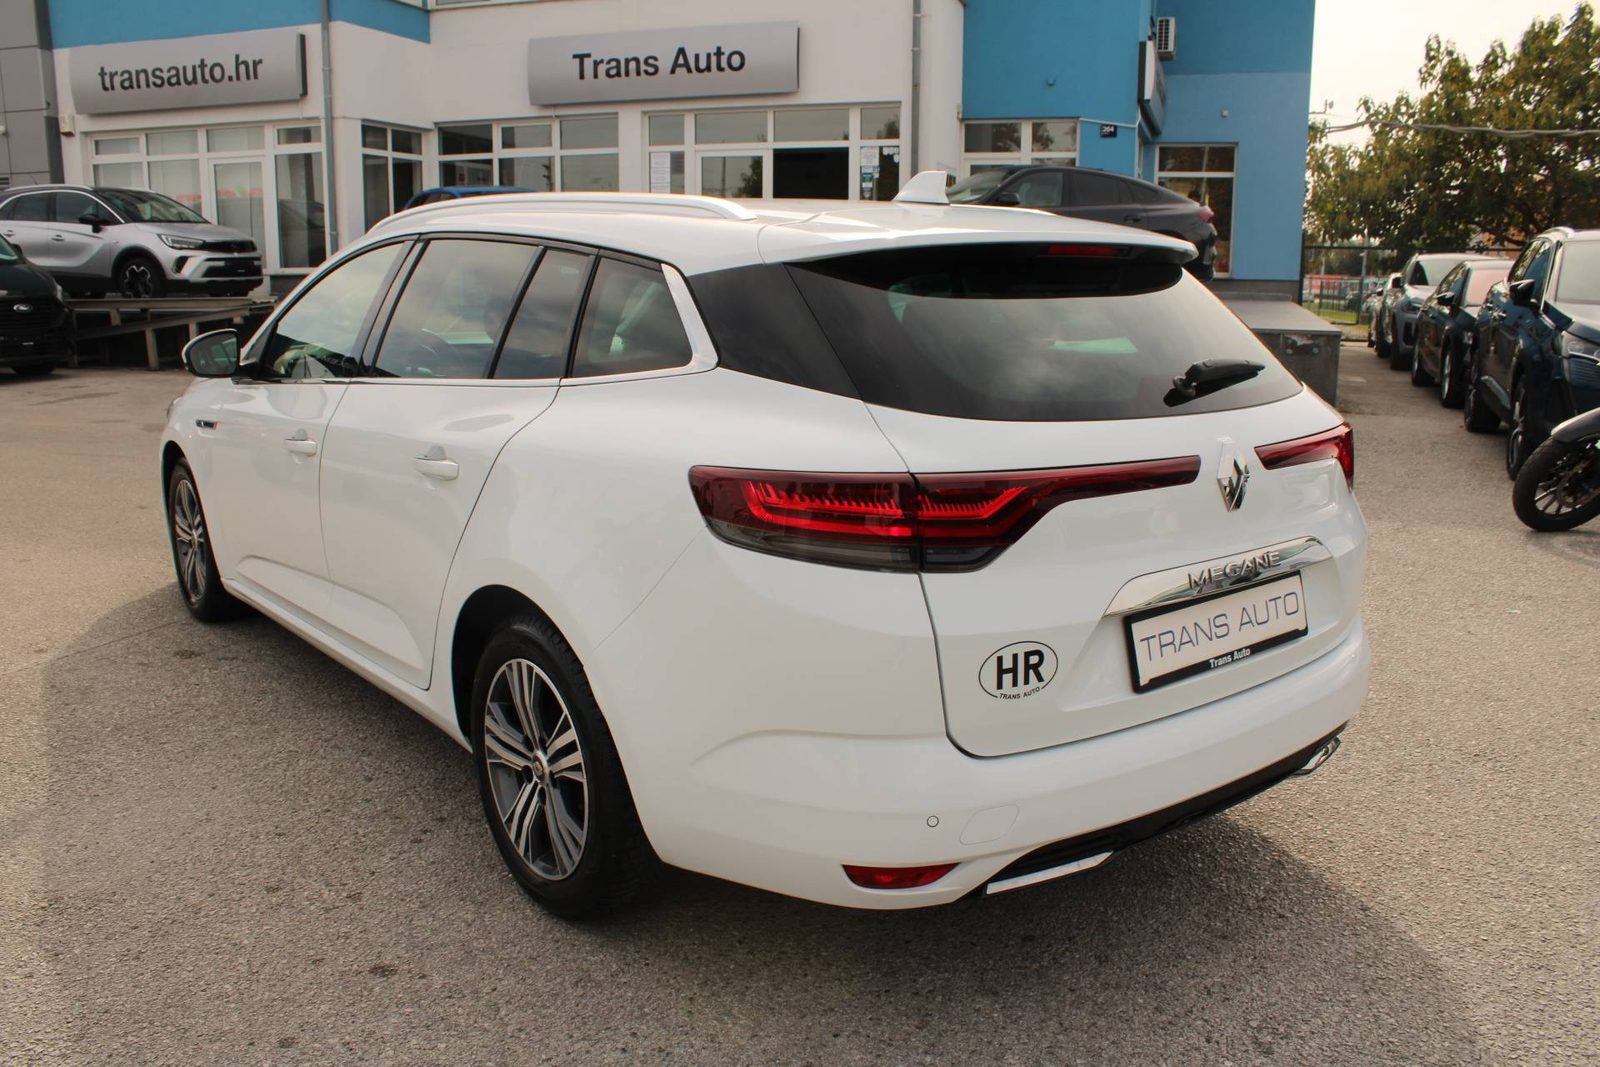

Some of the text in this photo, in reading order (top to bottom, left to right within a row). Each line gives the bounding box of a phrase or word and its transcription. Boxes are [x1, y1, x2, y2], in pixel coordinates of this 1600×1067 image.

[98, 54, 263, 92] transauto.hr
[572, 46, 746, 80] Trans Auto
[1188, 551, 1281, 588] MEGANE
[1140, 591, 1299, 661] TRANS AUTO
[996, 649, 1045, 690] HR
[1209, 648, 1250, 669] Trans Auto
[1023, 686, 1040, 698] AUTO
